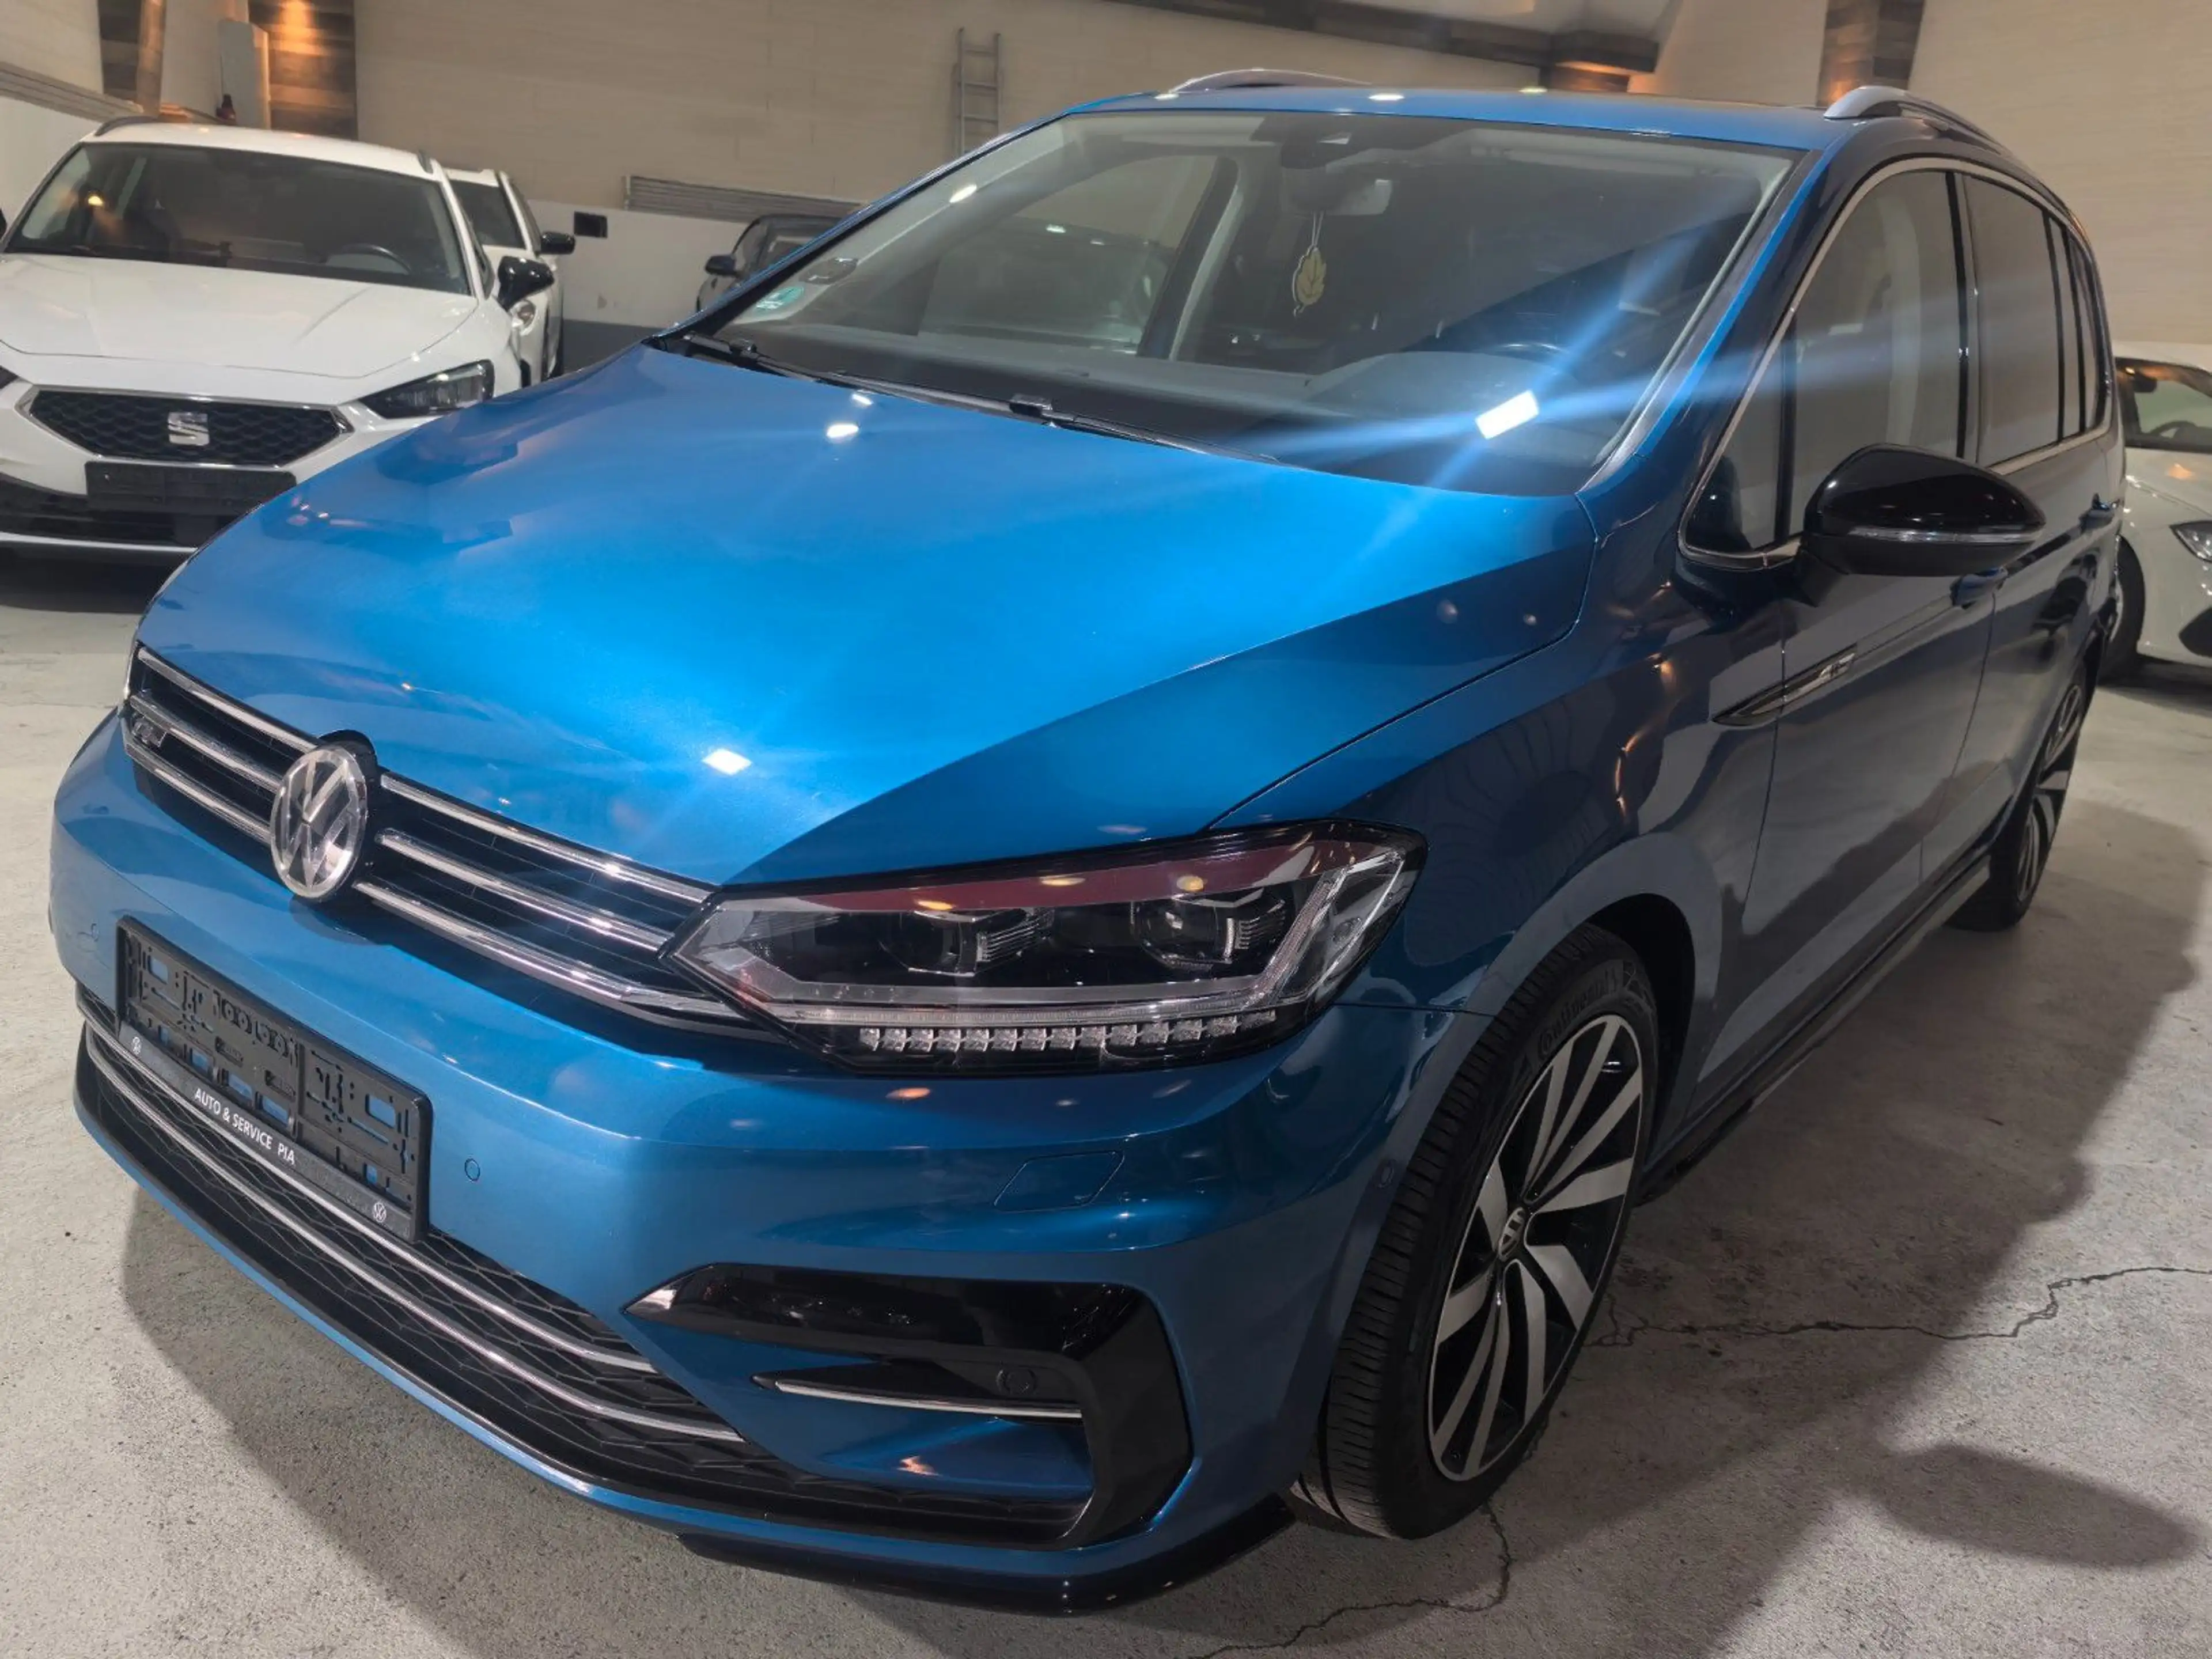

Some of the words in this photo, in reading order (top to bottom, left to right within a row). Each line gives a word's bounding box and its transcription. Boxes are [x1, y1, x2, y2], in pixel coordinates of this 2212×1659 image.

[194, 1087, 221, 1115] AUTO
[222, 1107, 230, 1123] &
[232, 1113, 274, 1150] SERVICE
[277, 1142, 296, 1165] PIA
